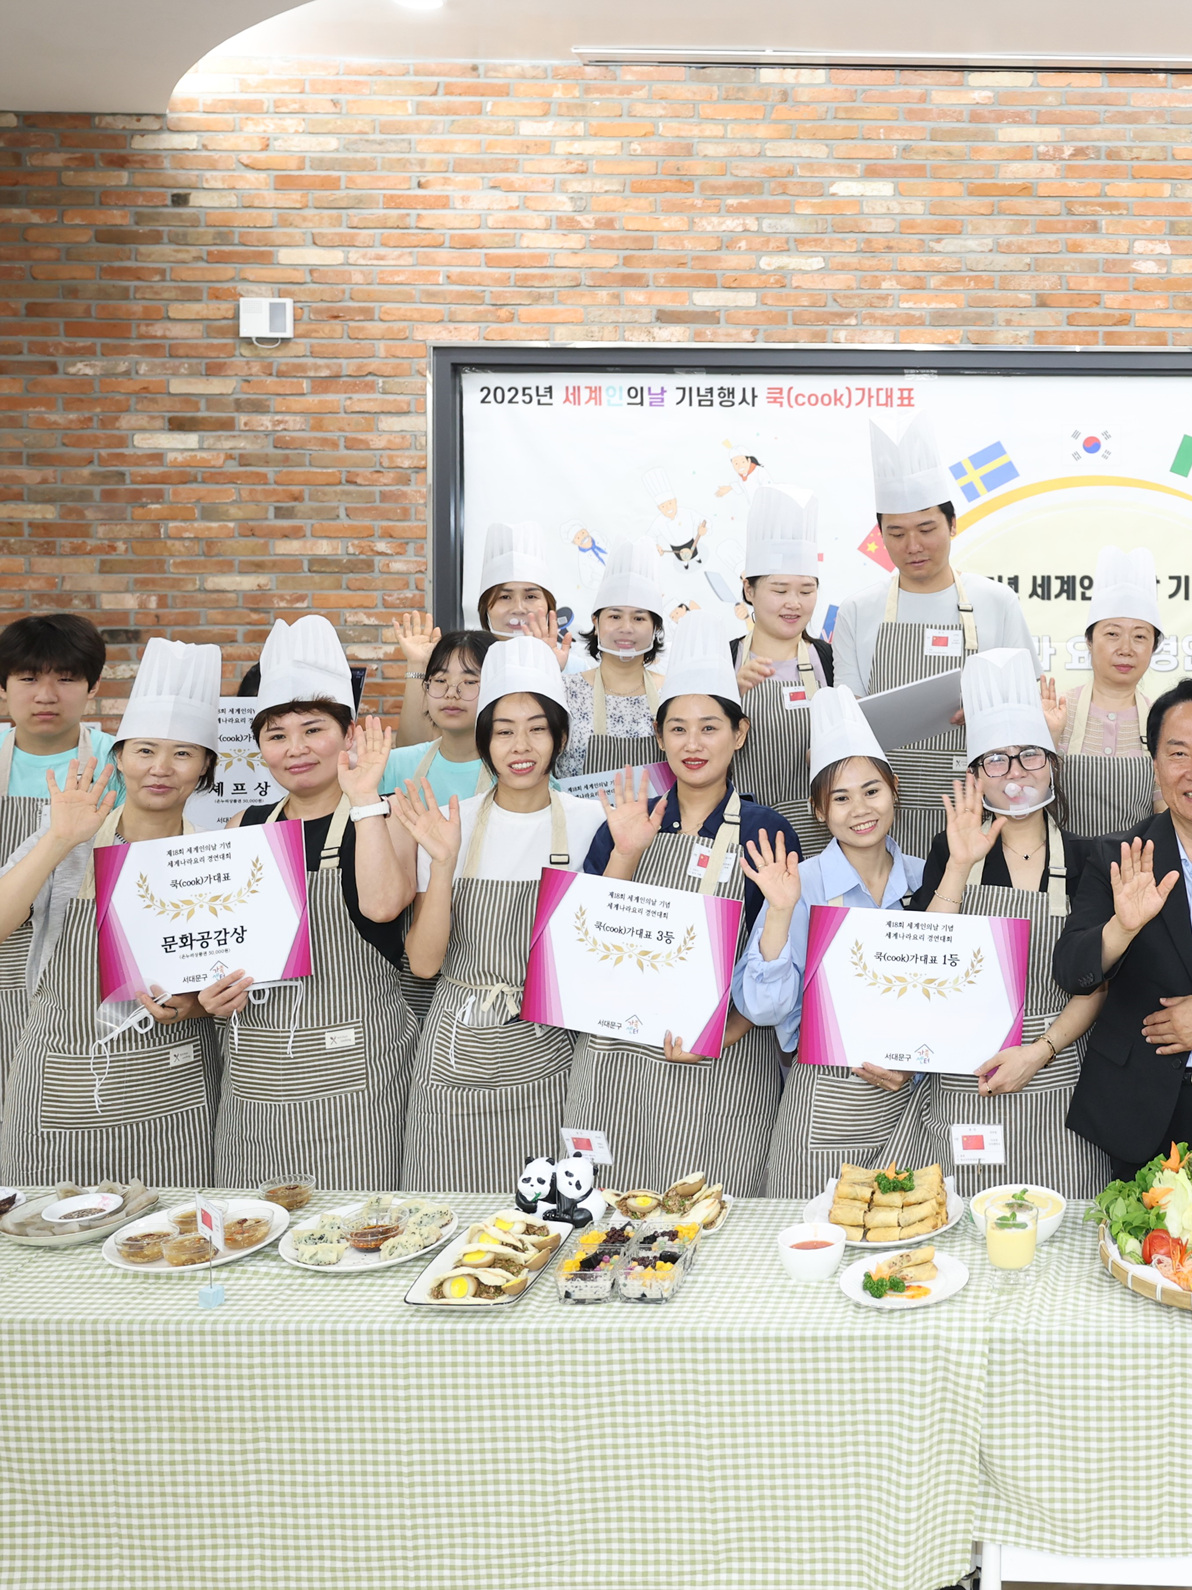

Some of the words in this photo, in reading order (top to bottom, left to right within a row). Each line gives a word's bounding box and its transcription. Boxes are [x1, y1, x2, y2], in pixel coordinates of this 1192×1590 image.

[480, 385, 554, 406] 2025년
[563, 385, 667, 407] 세계인의날
[675, 385, 759, 408] 기념행사
[765, 385, 916, 409] 쿡(cook)가대표
[170, 872, 231, 890] 쿡(cook)가대표
[161, 925, 248, 954] 문화공감상
[594, 920, 652, 940] 쿡(cook)가대표
[656, 930, 675, 945] 3등
[874, 951, 938, 965] 쿡(cook)가대표
[942, 953, 960, 967] 1등
